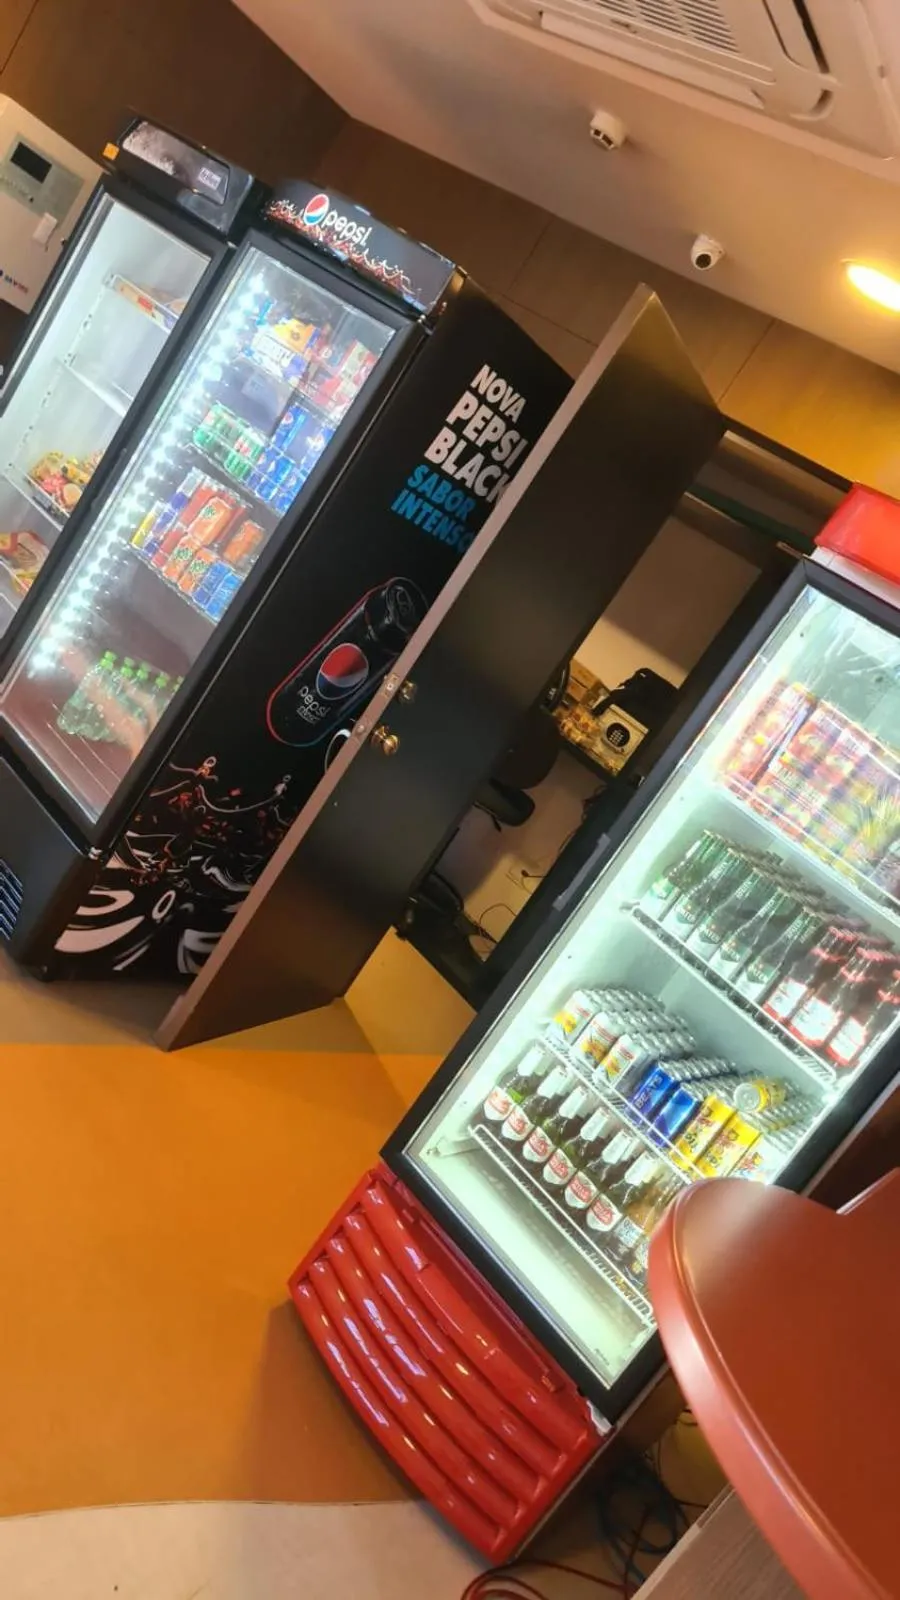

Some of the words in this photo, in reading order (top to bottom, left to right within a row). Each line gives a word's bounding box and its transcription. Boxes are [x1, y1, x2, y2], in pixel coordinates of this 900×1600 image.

[320, 209, 373, 248] pepsi
[470, 363, 527, 424] NOVA
[445, 390, 529, 469] PEPSI
[407, 464, 477, 522] SABOR
[423, 426, 513, 504] BLACK
[297, 685, 332, 718] pepsi
[635, 1074, 664, 1109] BEATS
